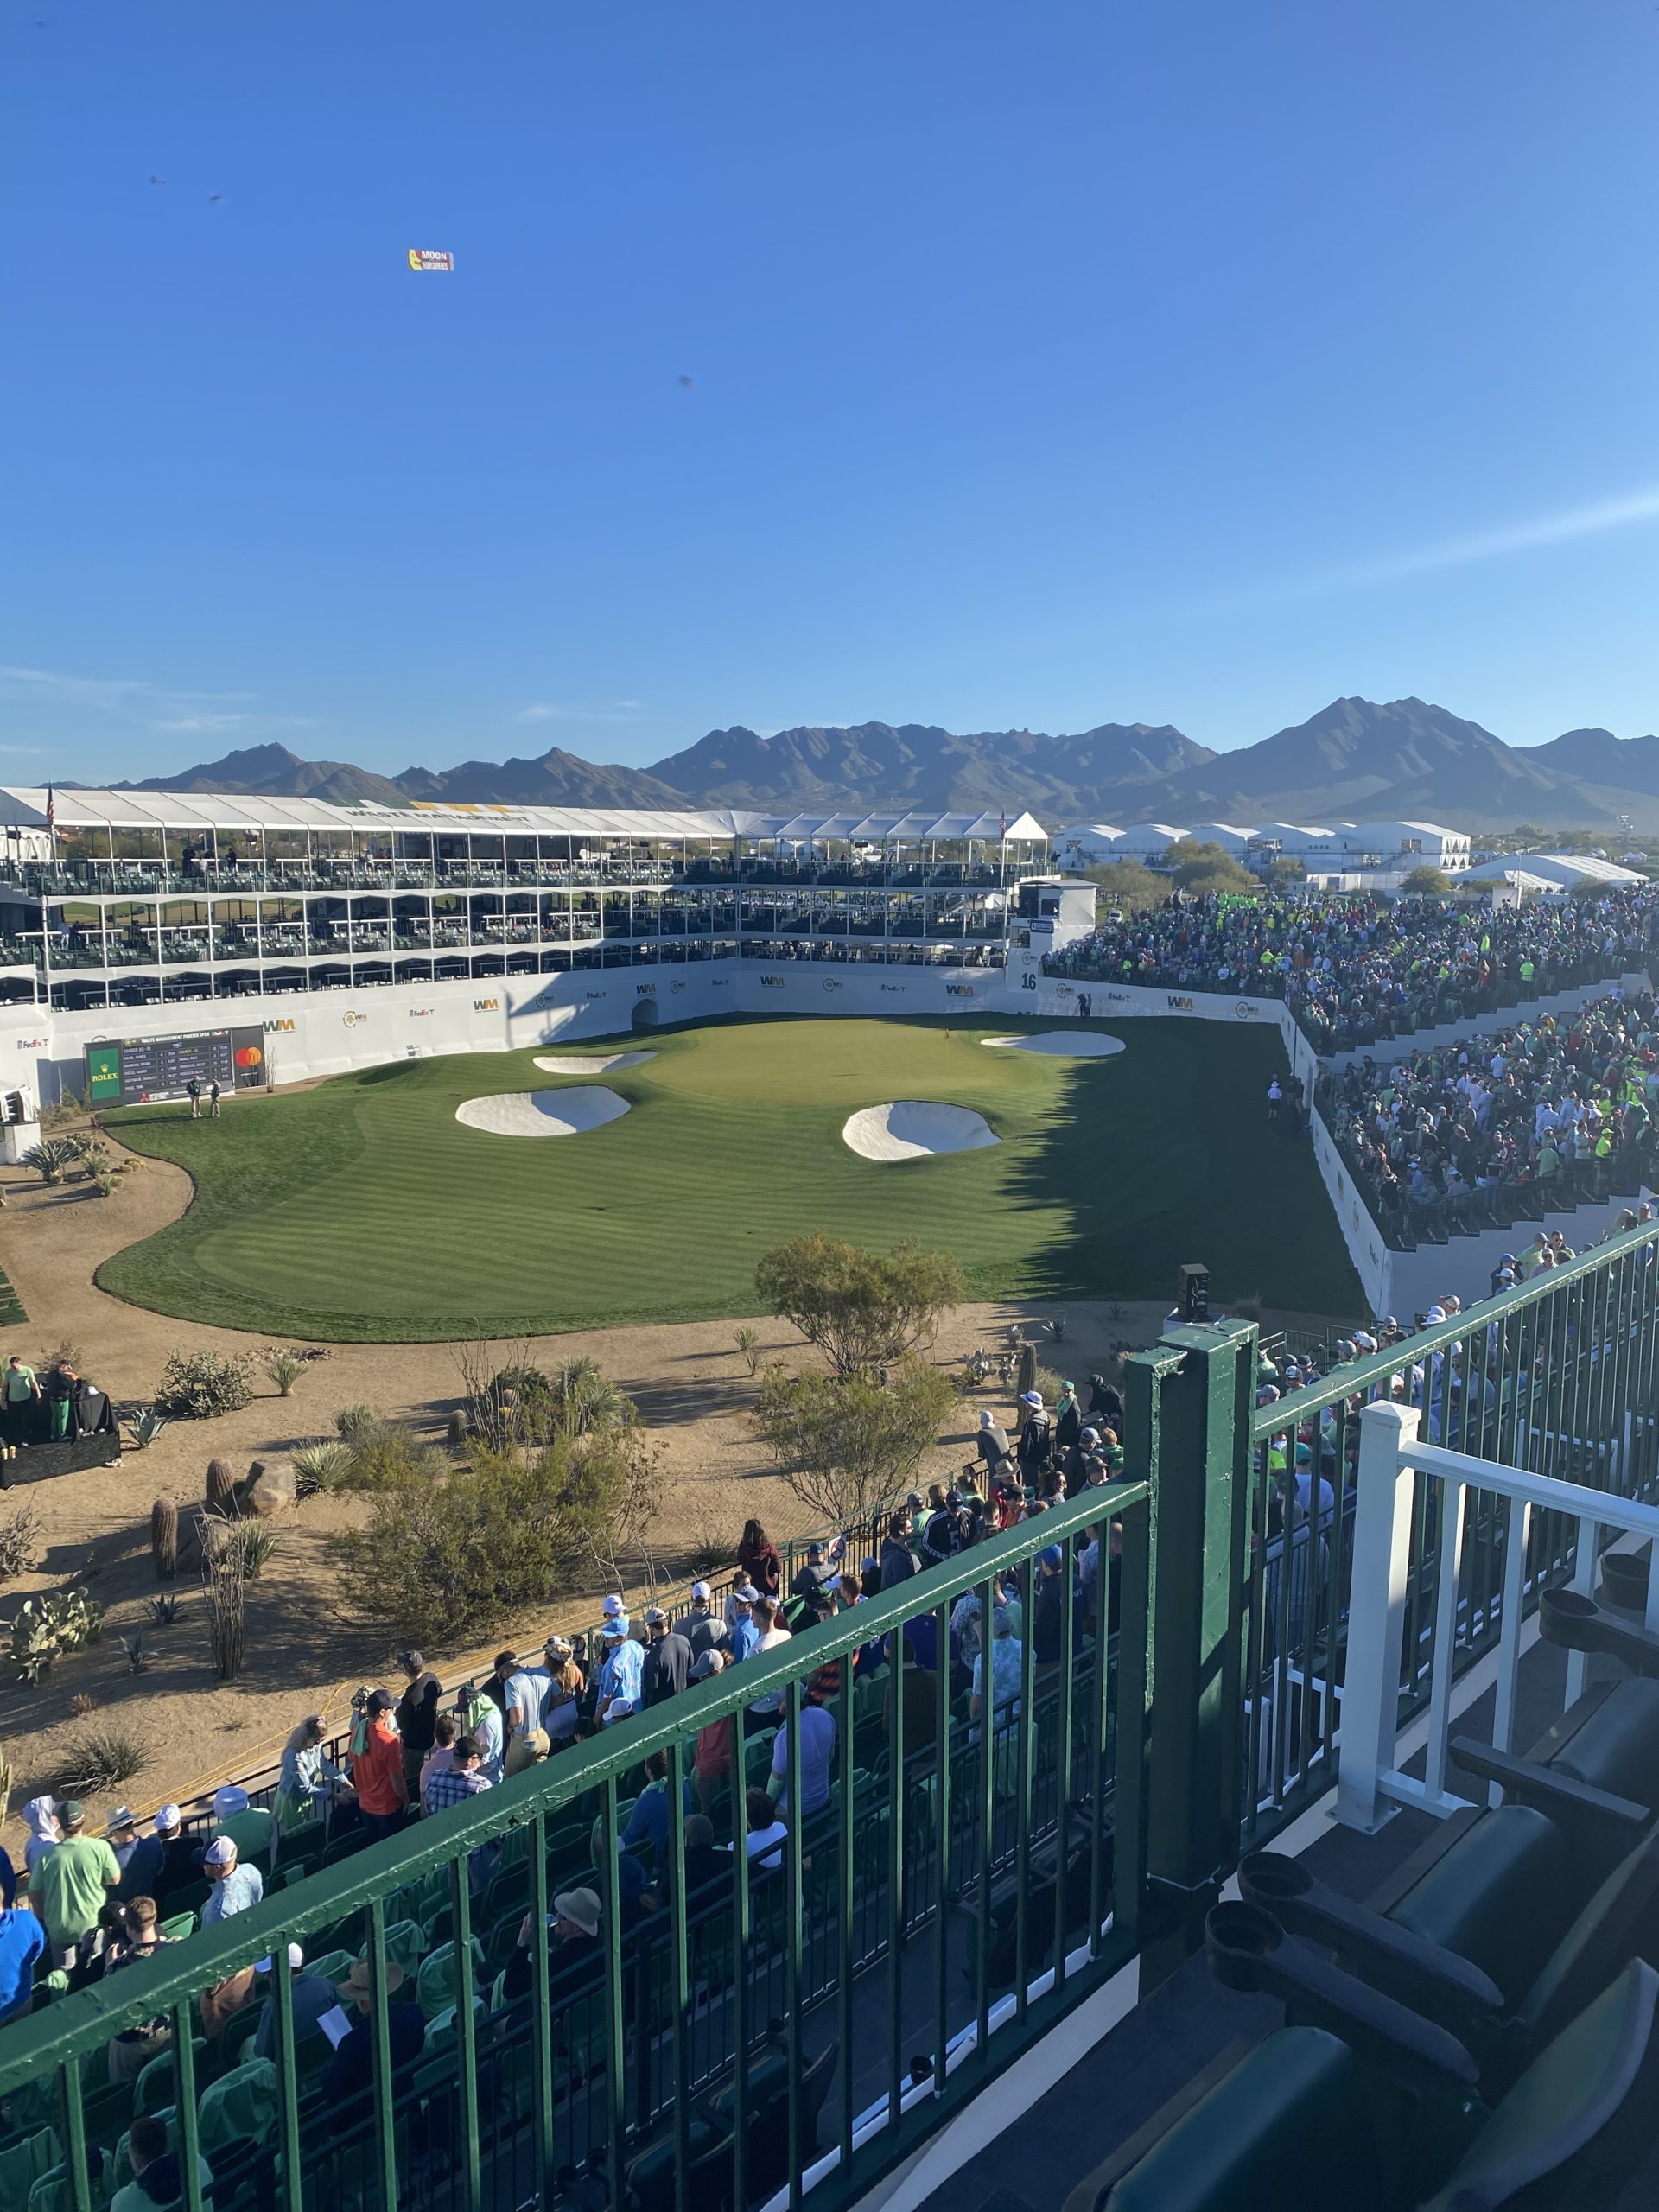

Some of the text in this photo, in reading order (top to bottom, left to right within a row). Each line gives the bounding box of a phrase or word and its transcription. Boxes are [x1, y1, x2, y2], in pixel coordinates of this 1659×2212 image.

[421, 251, 447, 260] MOON
[414, 812, 530, 822] MANAGEMENT
[760, 976, 785, 985] WM
[1021, 972, 1037, 990] 16
[636, 983, 656, 994] WM
[946, 985, 974, 995] WM
[474, 998, 499, 1010] WM
[1167, 995, 1194, 1008] WM
[262, 1018, 296, 1033] WM
[23, 1039, 41, 1048] FedEx
[92, 1072, 118, 1082] ROLEX
